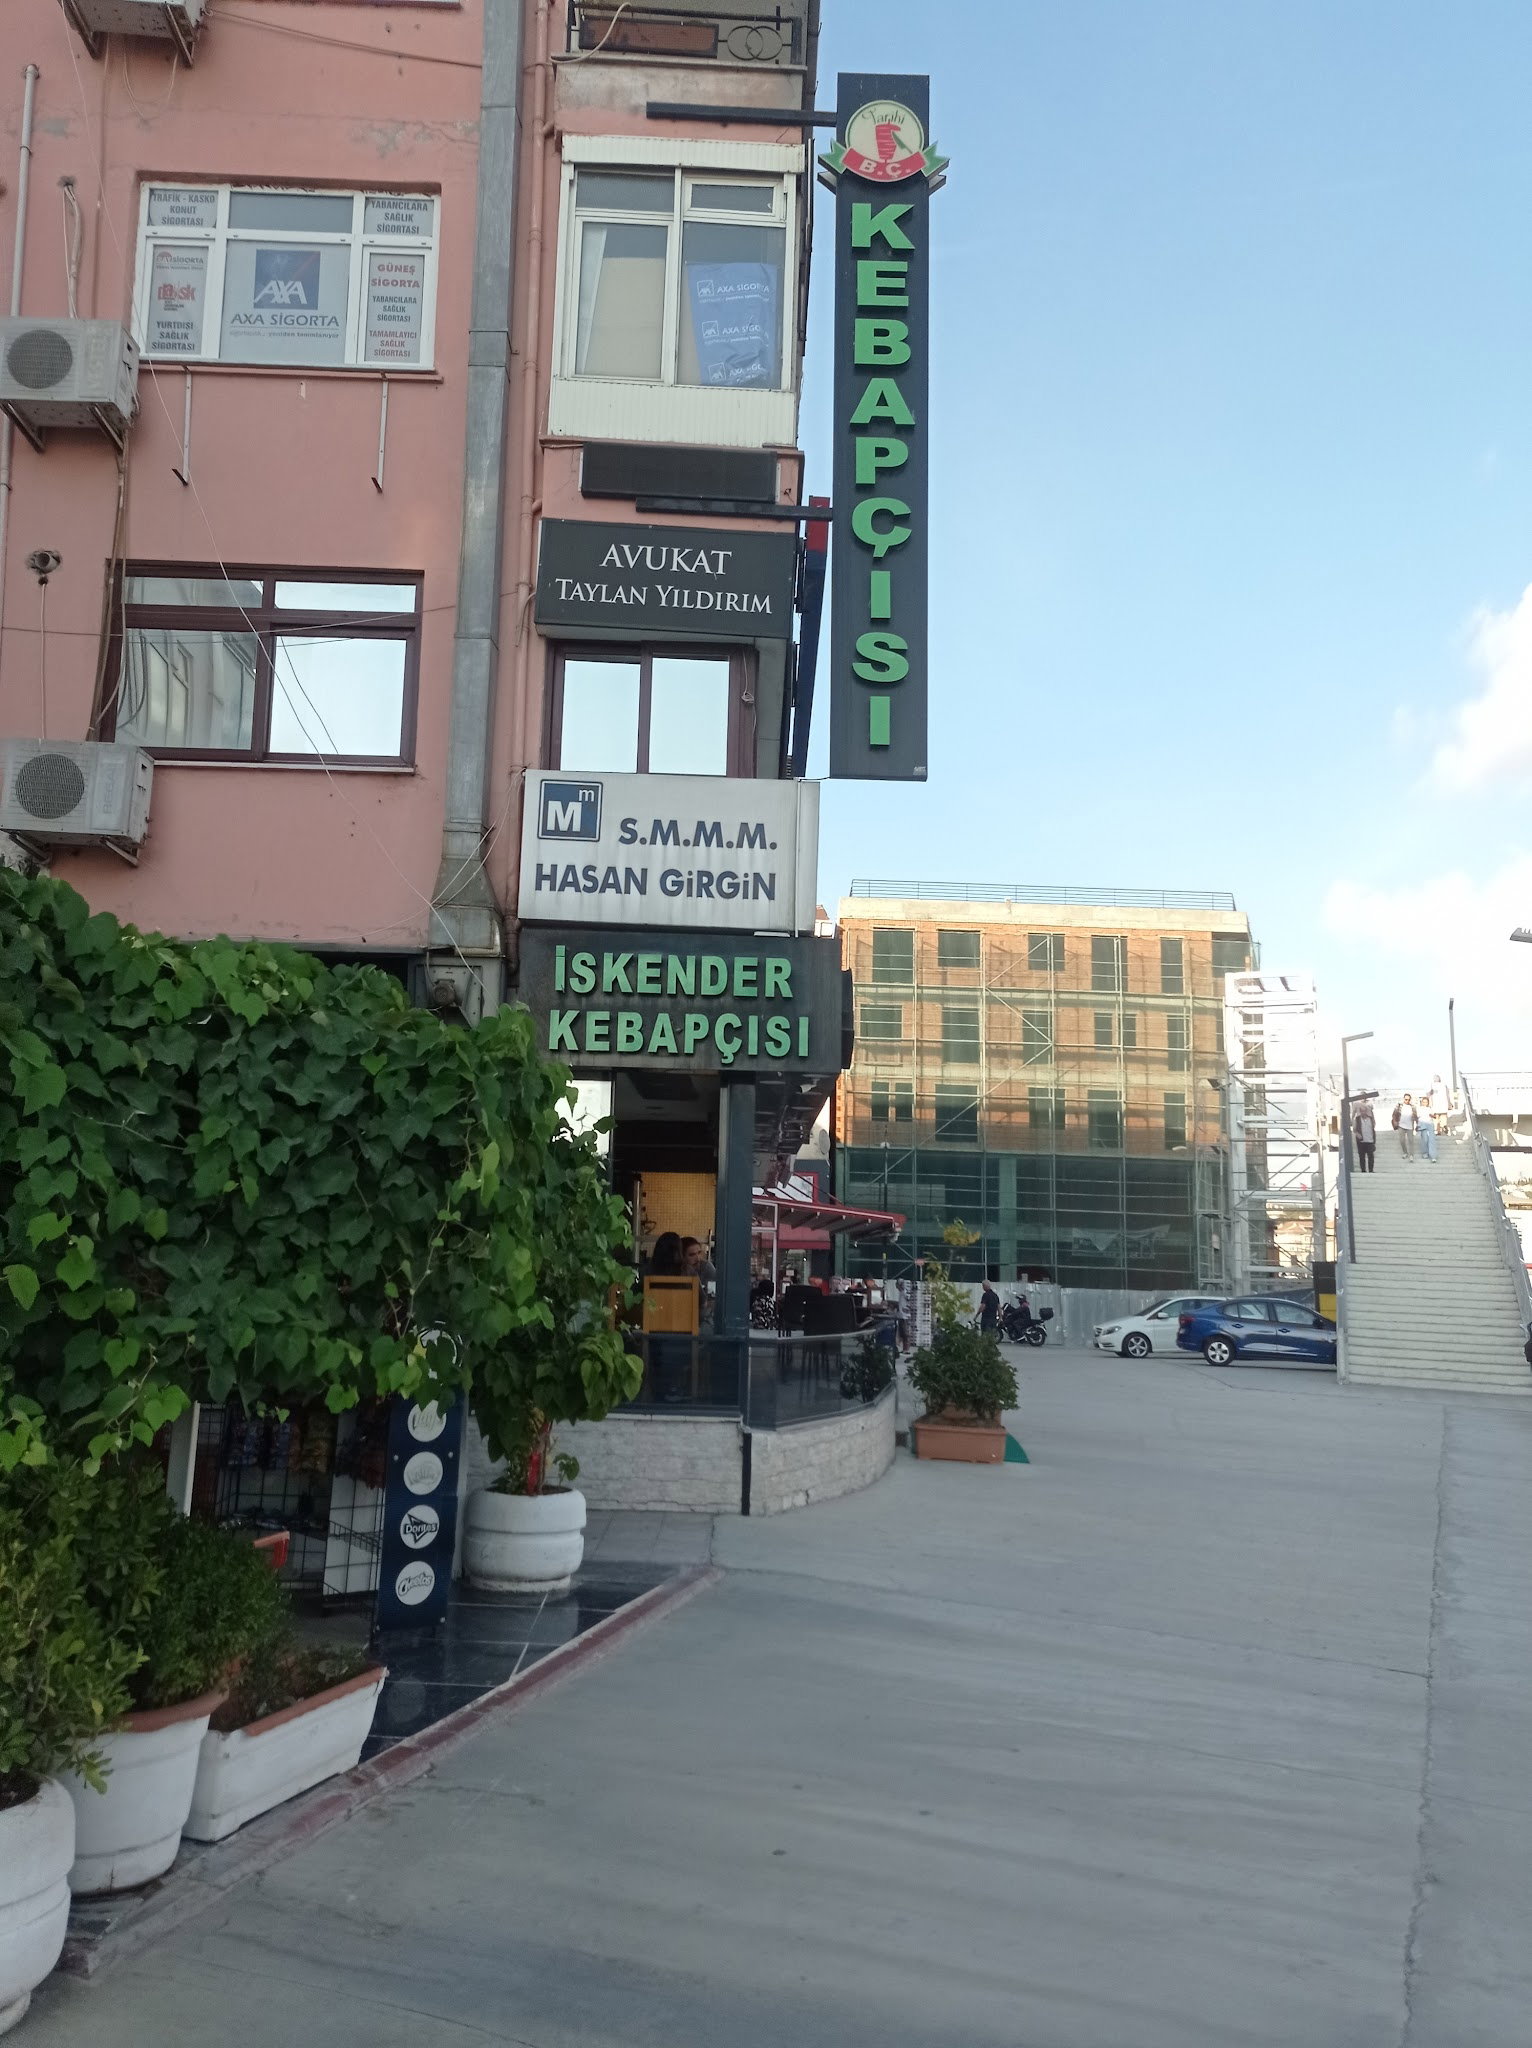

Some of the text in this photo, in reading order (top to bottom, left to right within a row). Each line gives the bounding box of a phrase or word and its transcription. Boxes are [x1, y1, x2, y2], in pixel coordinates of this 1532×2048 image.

[860, 107, 906, 125] Tarihi
[188, 194, 215, 204] KASKO
[169, 205, 197, 215] KONUT
[371, 200, 428, 212] YABANCILARA
[161, 216, 204, 226] SİGORTASI
[384, 211, 414, 223] SAĞLIK
[376, 223, 420, 235] SİGORTASI
[377, 262, 417, 276] GÜNEŞ
[370, 276, 421, 289] SİGORTA
[254, 279, 309, 306] AXA
[717, 285, 735, 294] AXA
[372, 295, 418, 305] YABANCILARA
[382, 304, 407, 313] SAĞLIK
[230, 312, 341, 328] AXA SİGORTA
[377, 313, 412, 323] SİGORTASI
[160, 330, 190, 340] SAĞLIK
[369, 330, 418, 340] TAMAMLAYICI
[723, 327, 740, 336] AXA
[380, 338, 406, 348] SAĞLIK
[374, 348, 412, 358] SİGORTASI
[850, 203, 916, 746] KEBAPÇISI
[600, 543, 732, 575] AVUKAT
[555, 578, 773, 614] TAYLAN YILDIRIM
[619, 817, 778, 851] S.M.M.M.
[534, 863, 648, 896] HASAN
[555, 945, 793, 998] İSKENDER
[549, 1009, 809, 1064] KEBAPÇISI
